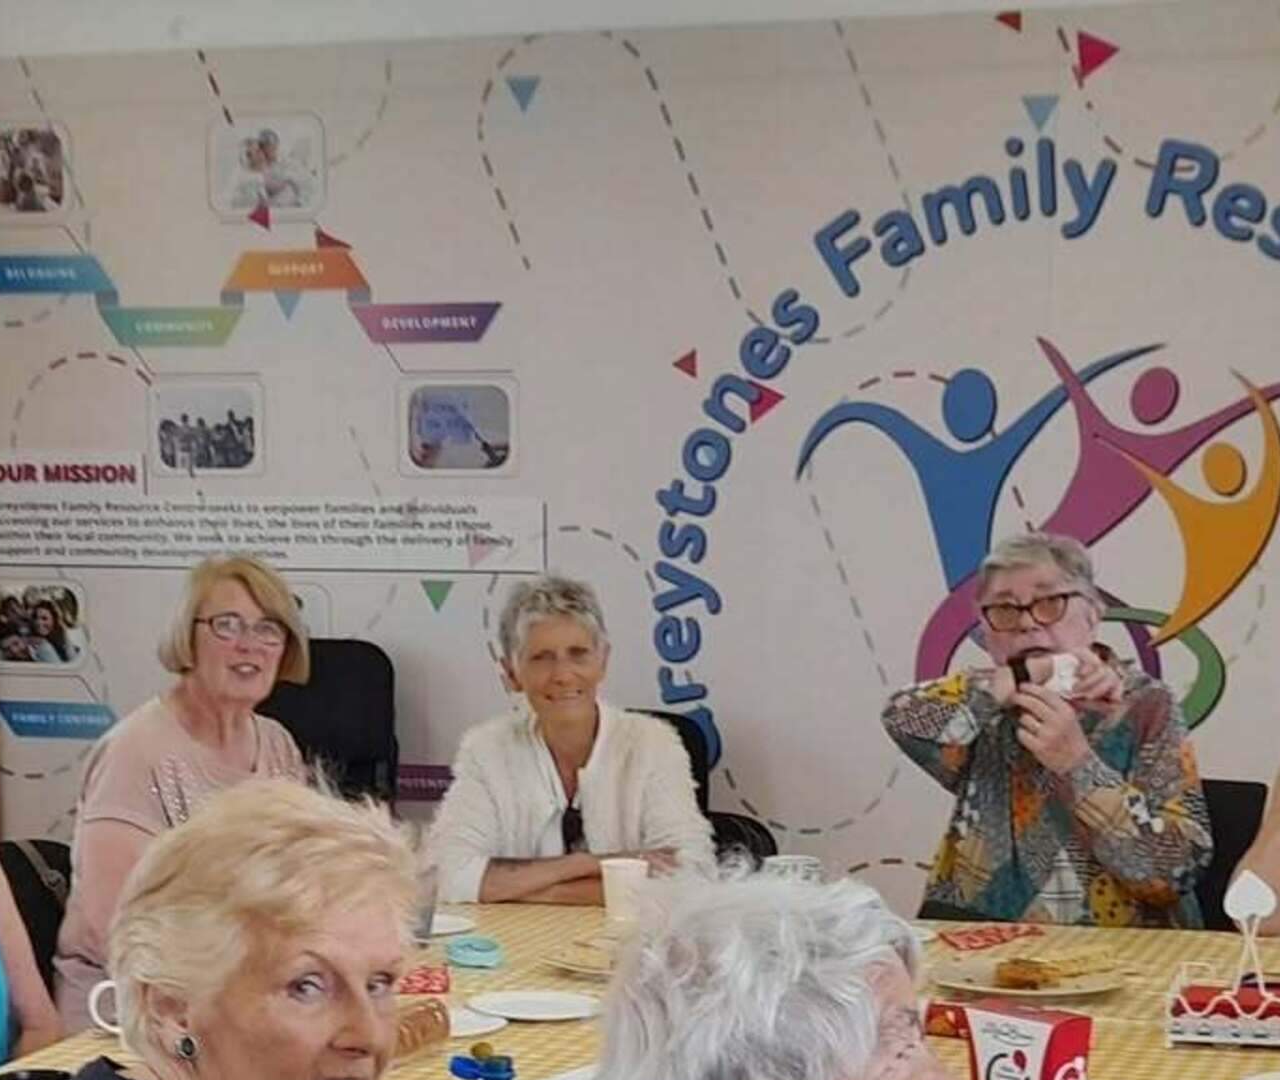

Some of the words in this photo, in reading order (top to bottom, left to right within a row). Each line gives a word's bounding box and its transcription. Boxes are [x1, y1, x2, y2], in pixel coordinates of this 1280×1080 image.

[135, 319, 214, 334] COMMUNITY
[381, 315, 477, 331] DEVELOPMENT
[652, 287, 820, 771] reystones
[813, 136, 1118, 298] Family
[43, 463, 137, 485] MISSION
